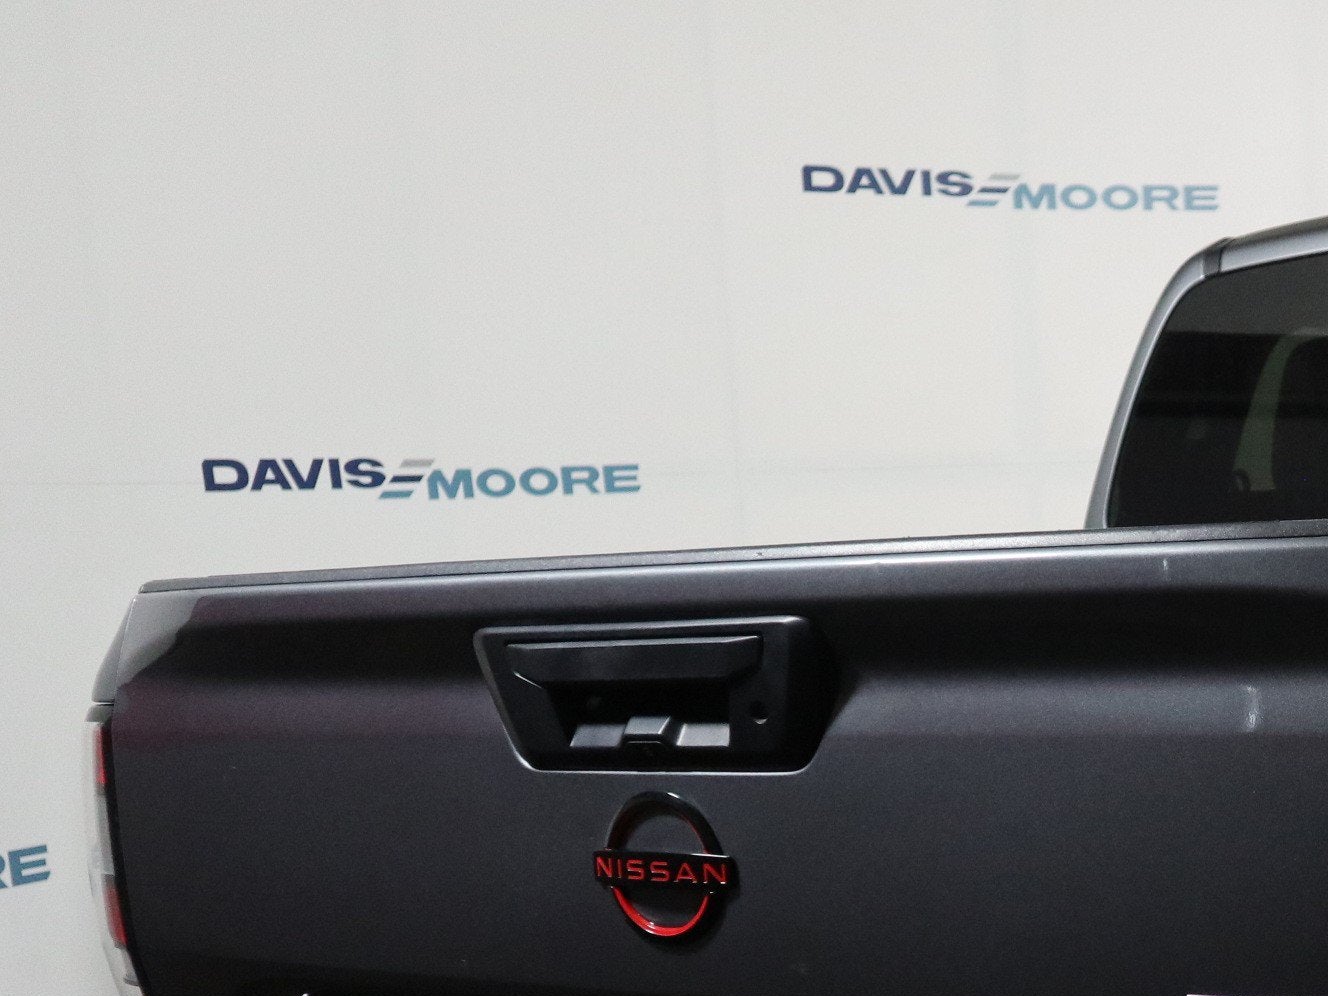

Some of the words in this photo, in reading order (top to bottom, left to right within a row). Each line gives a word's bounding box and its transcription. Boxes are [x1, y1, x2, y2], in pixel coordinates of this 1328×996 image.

[801, 165, 975, 196] DAVIS
[1013, 184, 1219, 211] MOORE
[202, 458, 386, 491] DAVIS
[427, 464, 641, 500] MOORE
[595, 856, 728, 885] NISSAN
